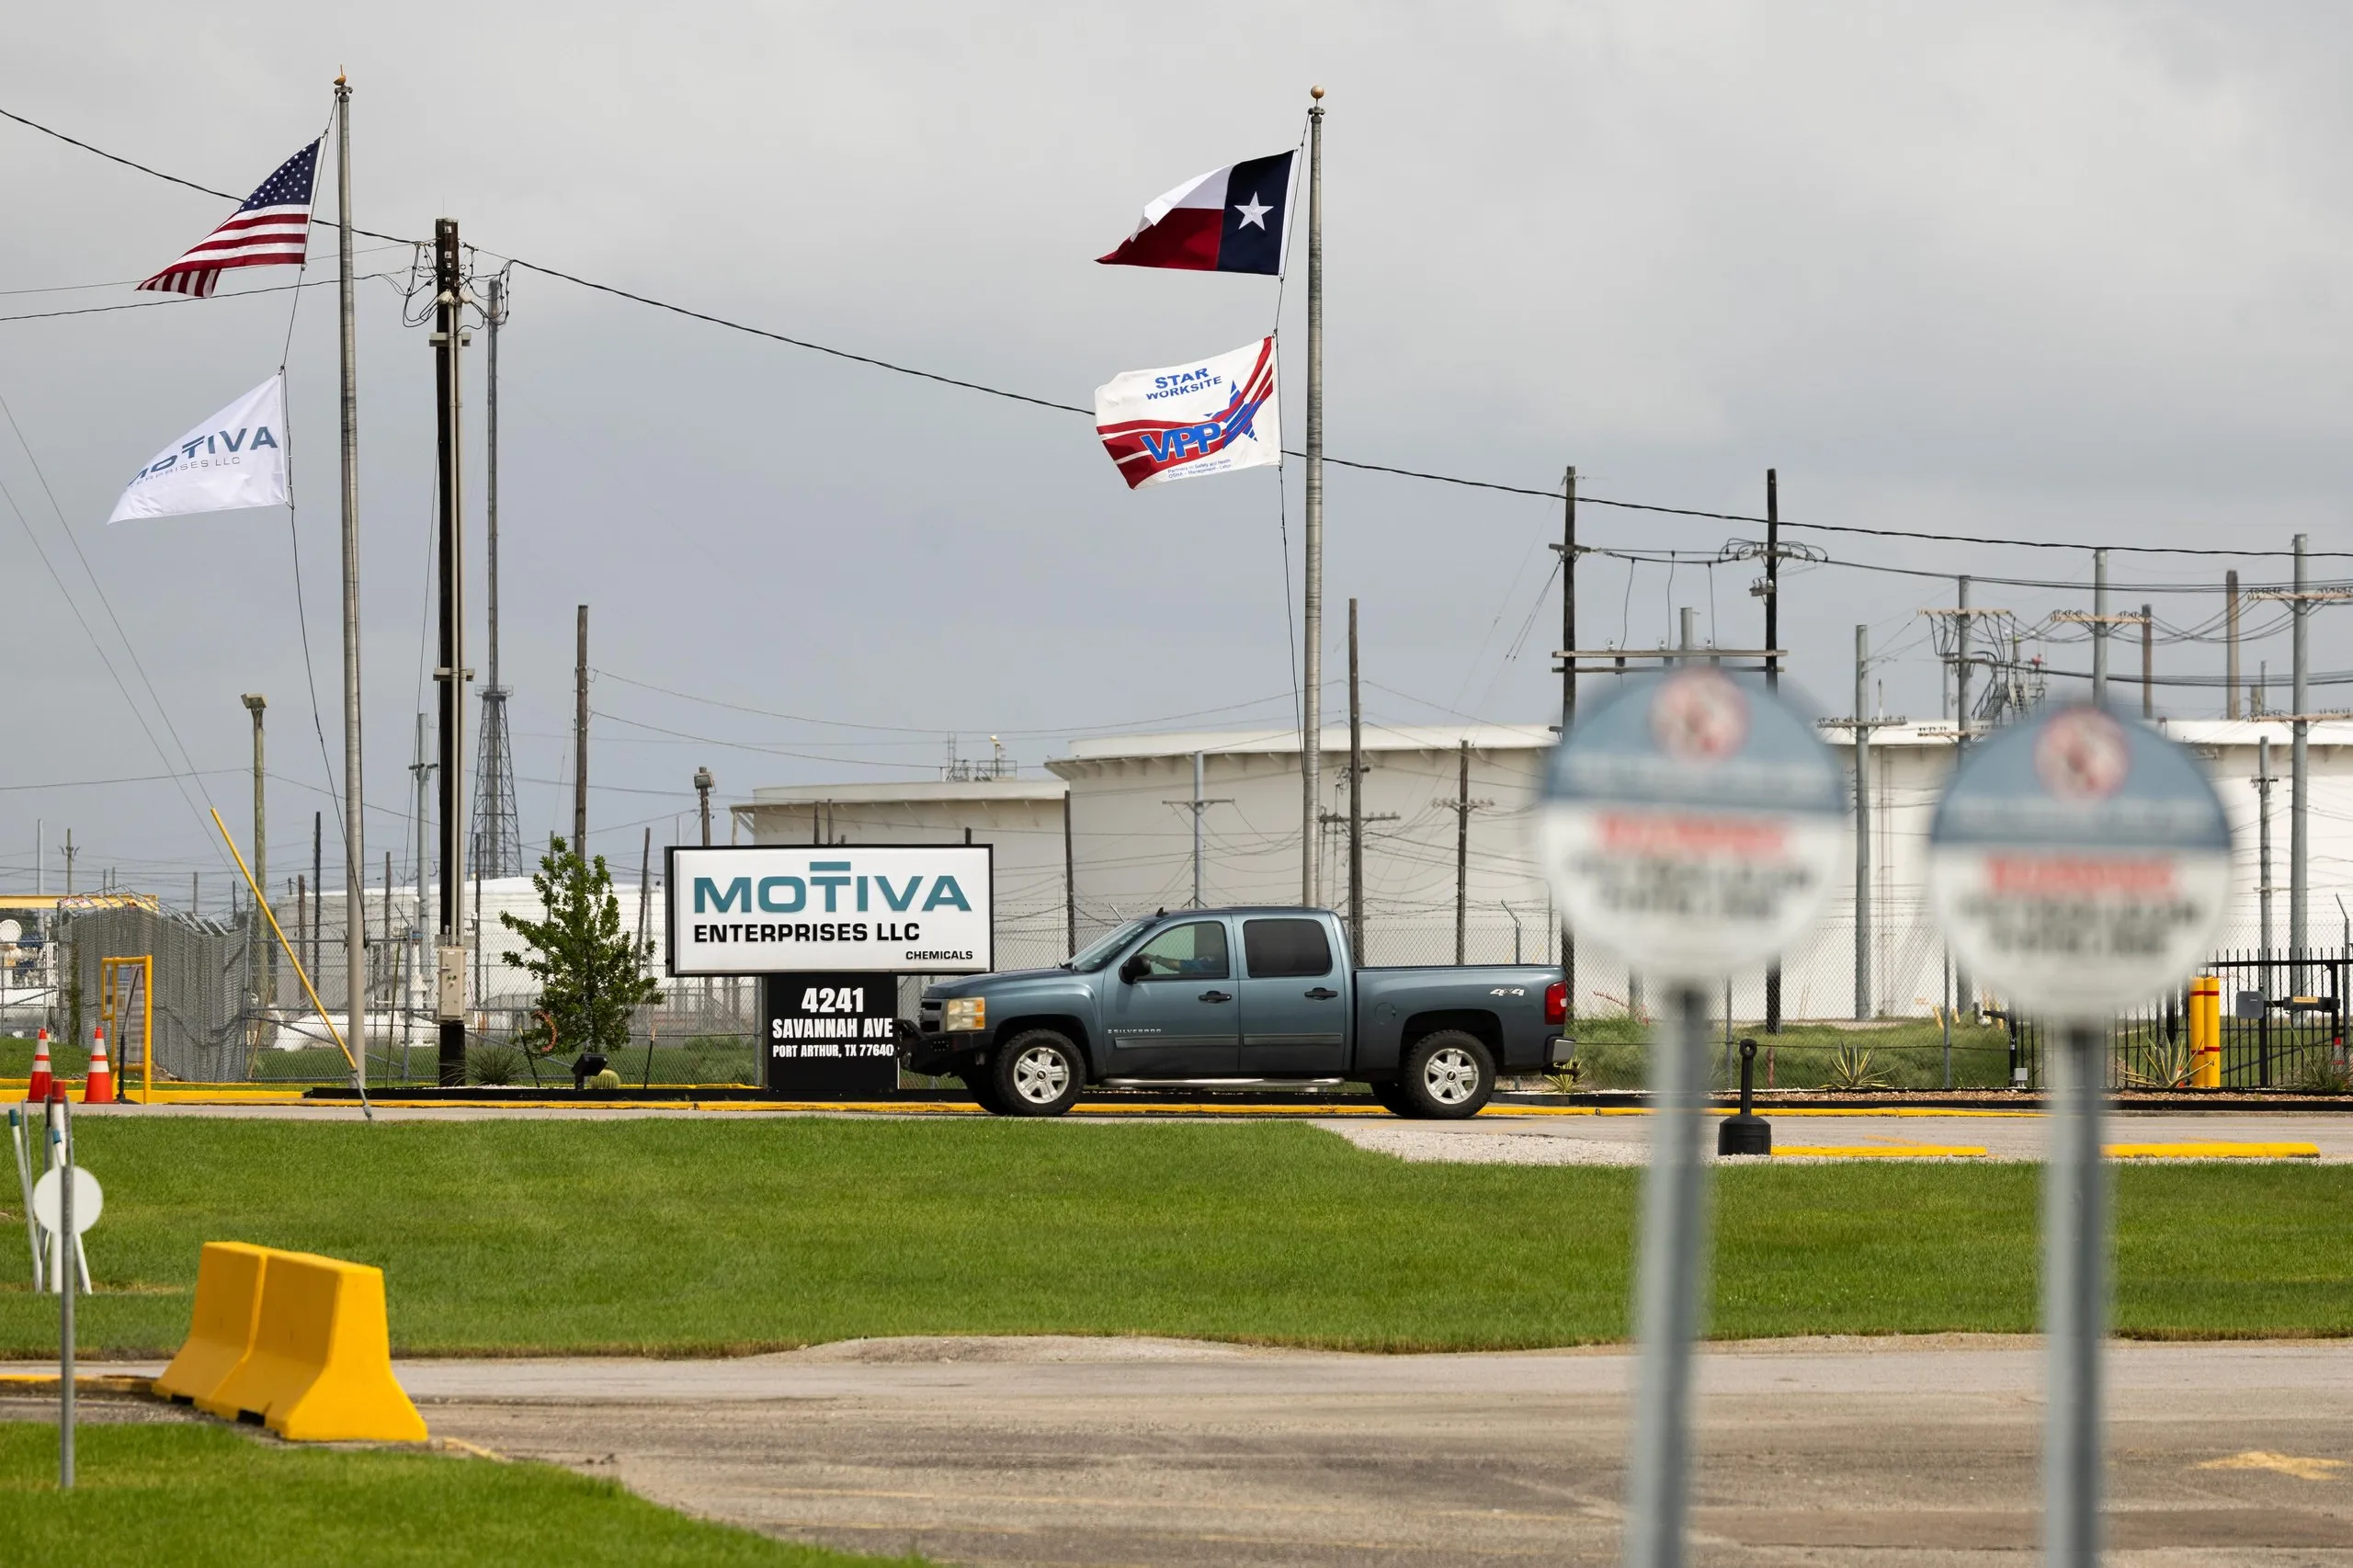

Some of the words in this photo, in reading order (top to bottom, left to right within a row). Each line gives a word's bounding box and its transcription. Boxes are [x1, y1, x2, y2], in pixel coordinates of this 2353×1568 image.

[1146, 376, 1222, 400] WORKSITE
[1154, 368, 1210, 390] STAR
[1141, 421, 1222, 463] VPP
[215, 457, 241, 467] LLC
[694, 861, 972, 914] MOTIVA
[694, 923, 868, 943] ENTERPRISES
[877, 922, 920, 941] LLC
[905, 950, 973, 960] CHEMICALS
[801, 987, 864, 1013] 4241
[772, 1018, 858, 1039] SAVANNAH
[863, 1017, 893, 1038] AVE
[772, 1045, 798, 1058] PORT
[801, 1044, 842, 1058] ARTHUR,
[845, 1044, 857, 1057] TX
[859, 1043, 894, 1057] 77640
